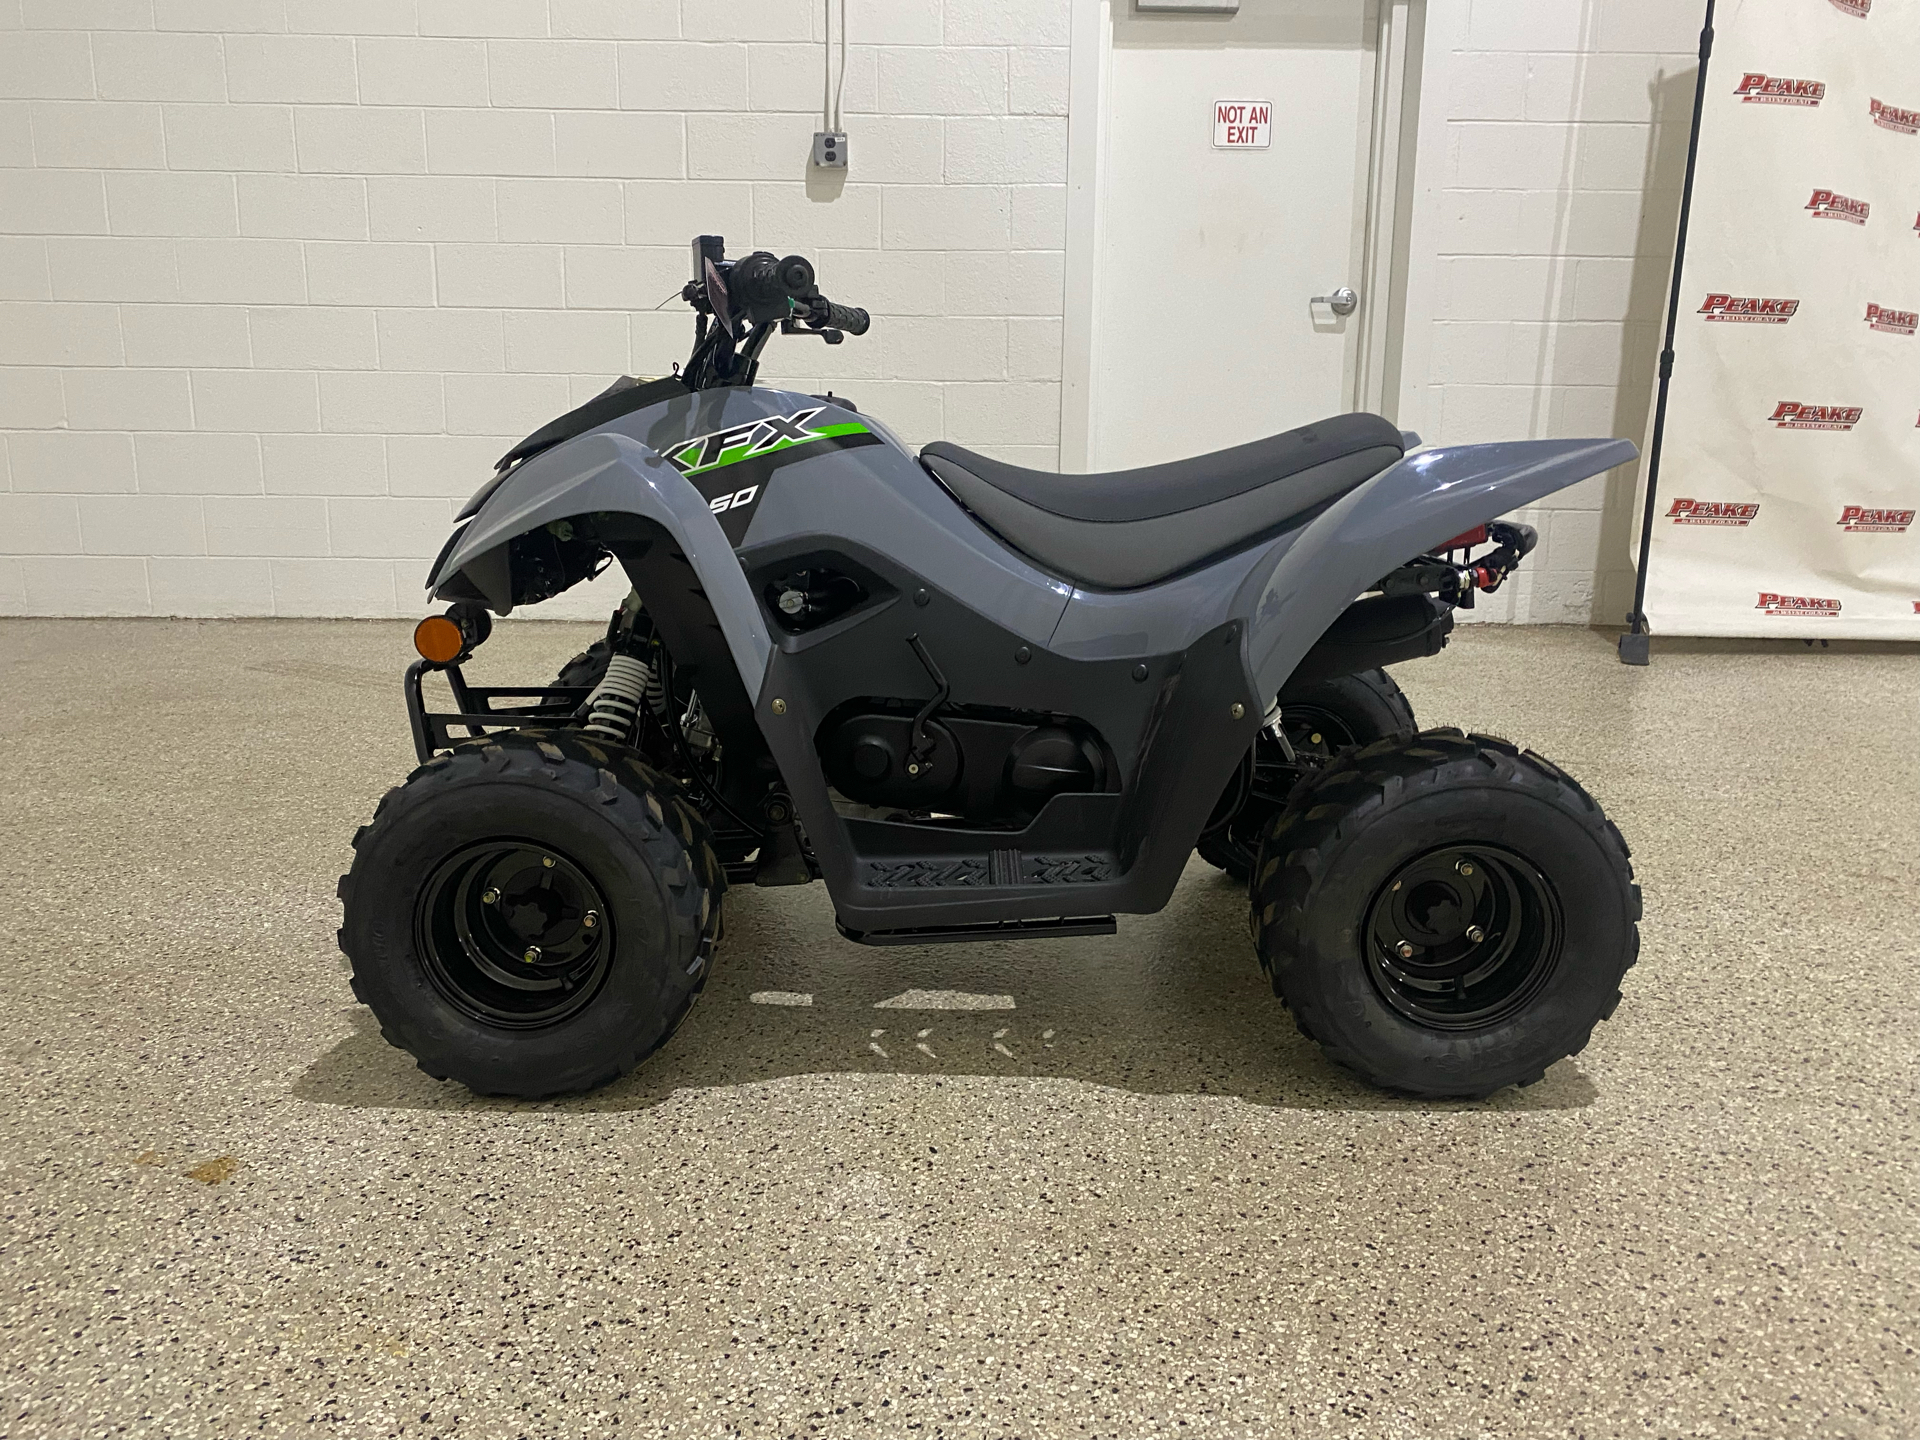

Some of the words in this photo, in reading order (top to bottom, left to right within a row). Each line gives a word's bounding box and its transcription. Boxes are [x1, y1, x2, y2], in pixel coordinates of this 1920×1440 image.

[1733, 73, 1825, 100] PEAKE
[1217, 106, 1246, 124] NOT
[1248, 106, 1269, 124] AN
[1227, 126, 1258, 144] EXIT
[1804, 189, 1870, 219] PEAKE
[1697, 293, 1799, 316] PEAKE
[1864, 302, 1919, 329] PEAKE
[1768, 401, 1863, 424] PEAKE
[1665, 498, 1759, 519] PEAKE
[1837, 506, 1916, 525] PEAKE
[1755, 592, 1841, 611] PEAKE
